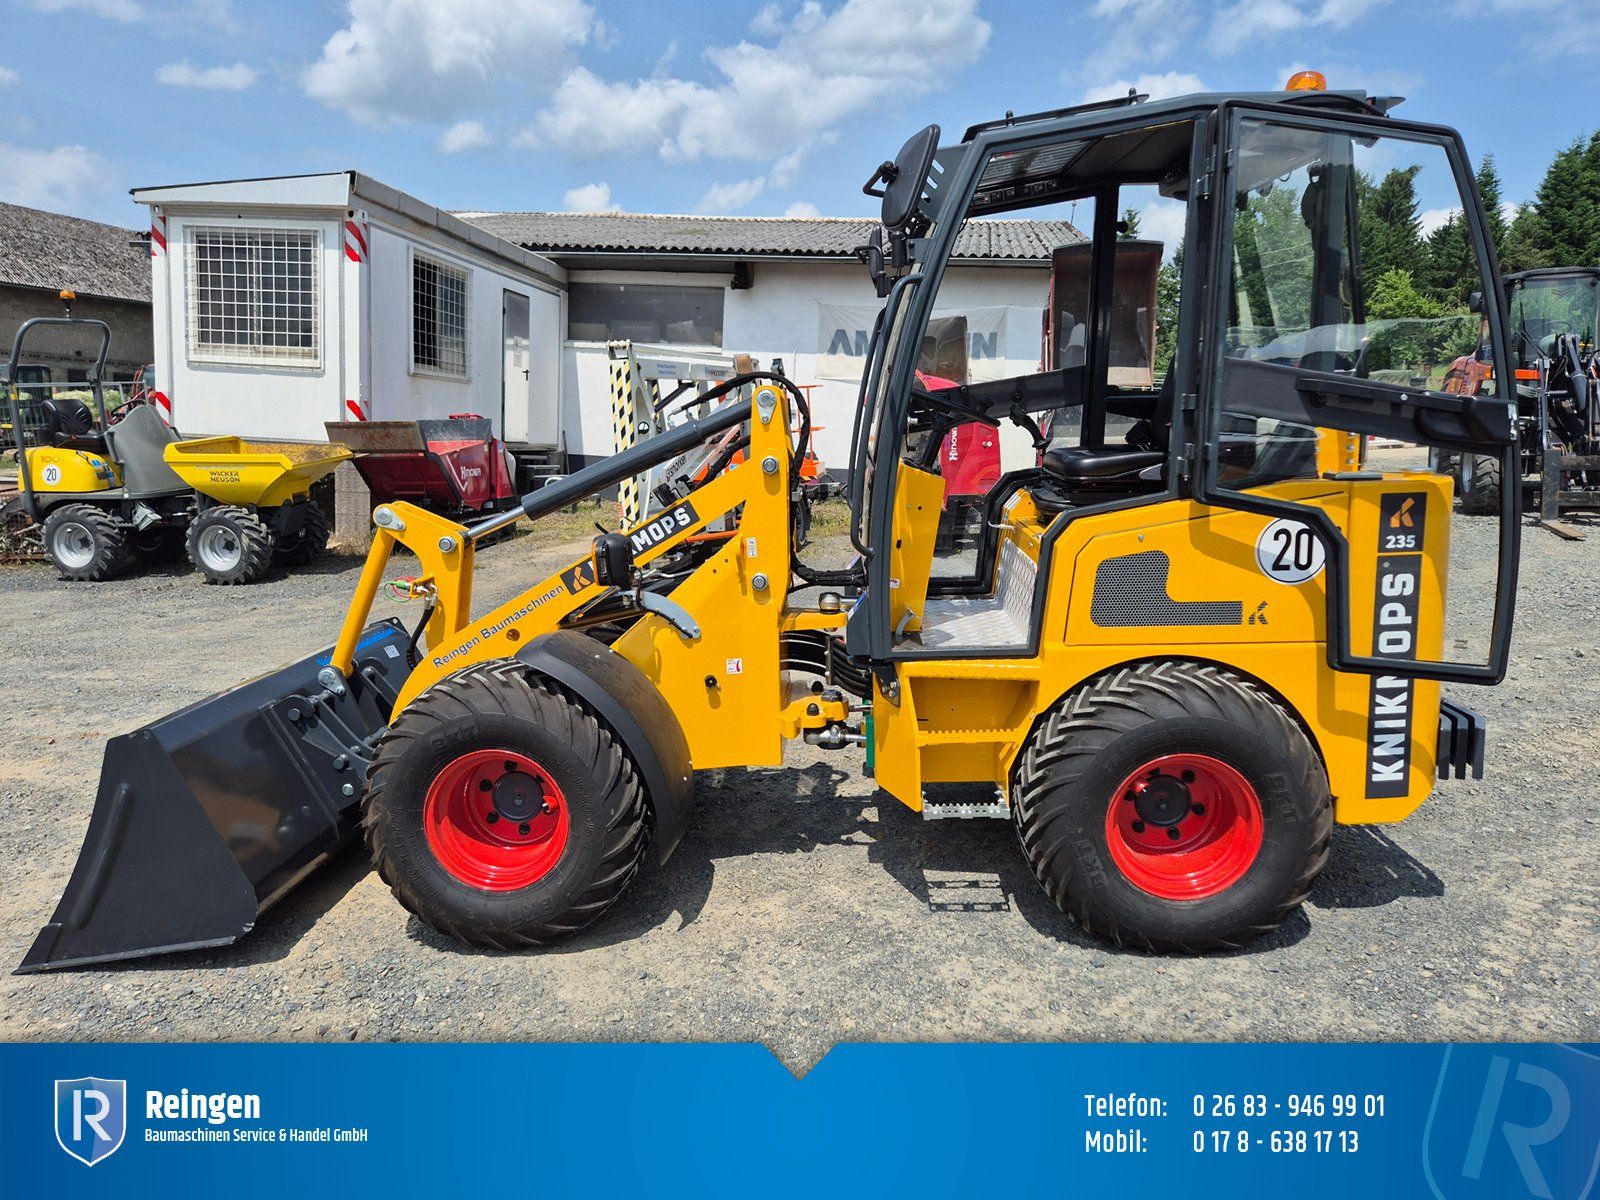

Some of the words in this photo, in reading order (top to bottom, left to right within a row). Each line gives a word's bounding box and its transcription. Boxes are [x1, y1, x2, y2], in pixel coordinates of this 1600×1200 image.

[46, 468, 57, 482] 20
[631, 507, 691, 555] MOPS
[1271, 527, 1314, 571] 20
[1385, 535, 1416, 549] 235
[432, 636, 481, 669] Reingen
[480, 584, 564, 640] Baumaschinen
